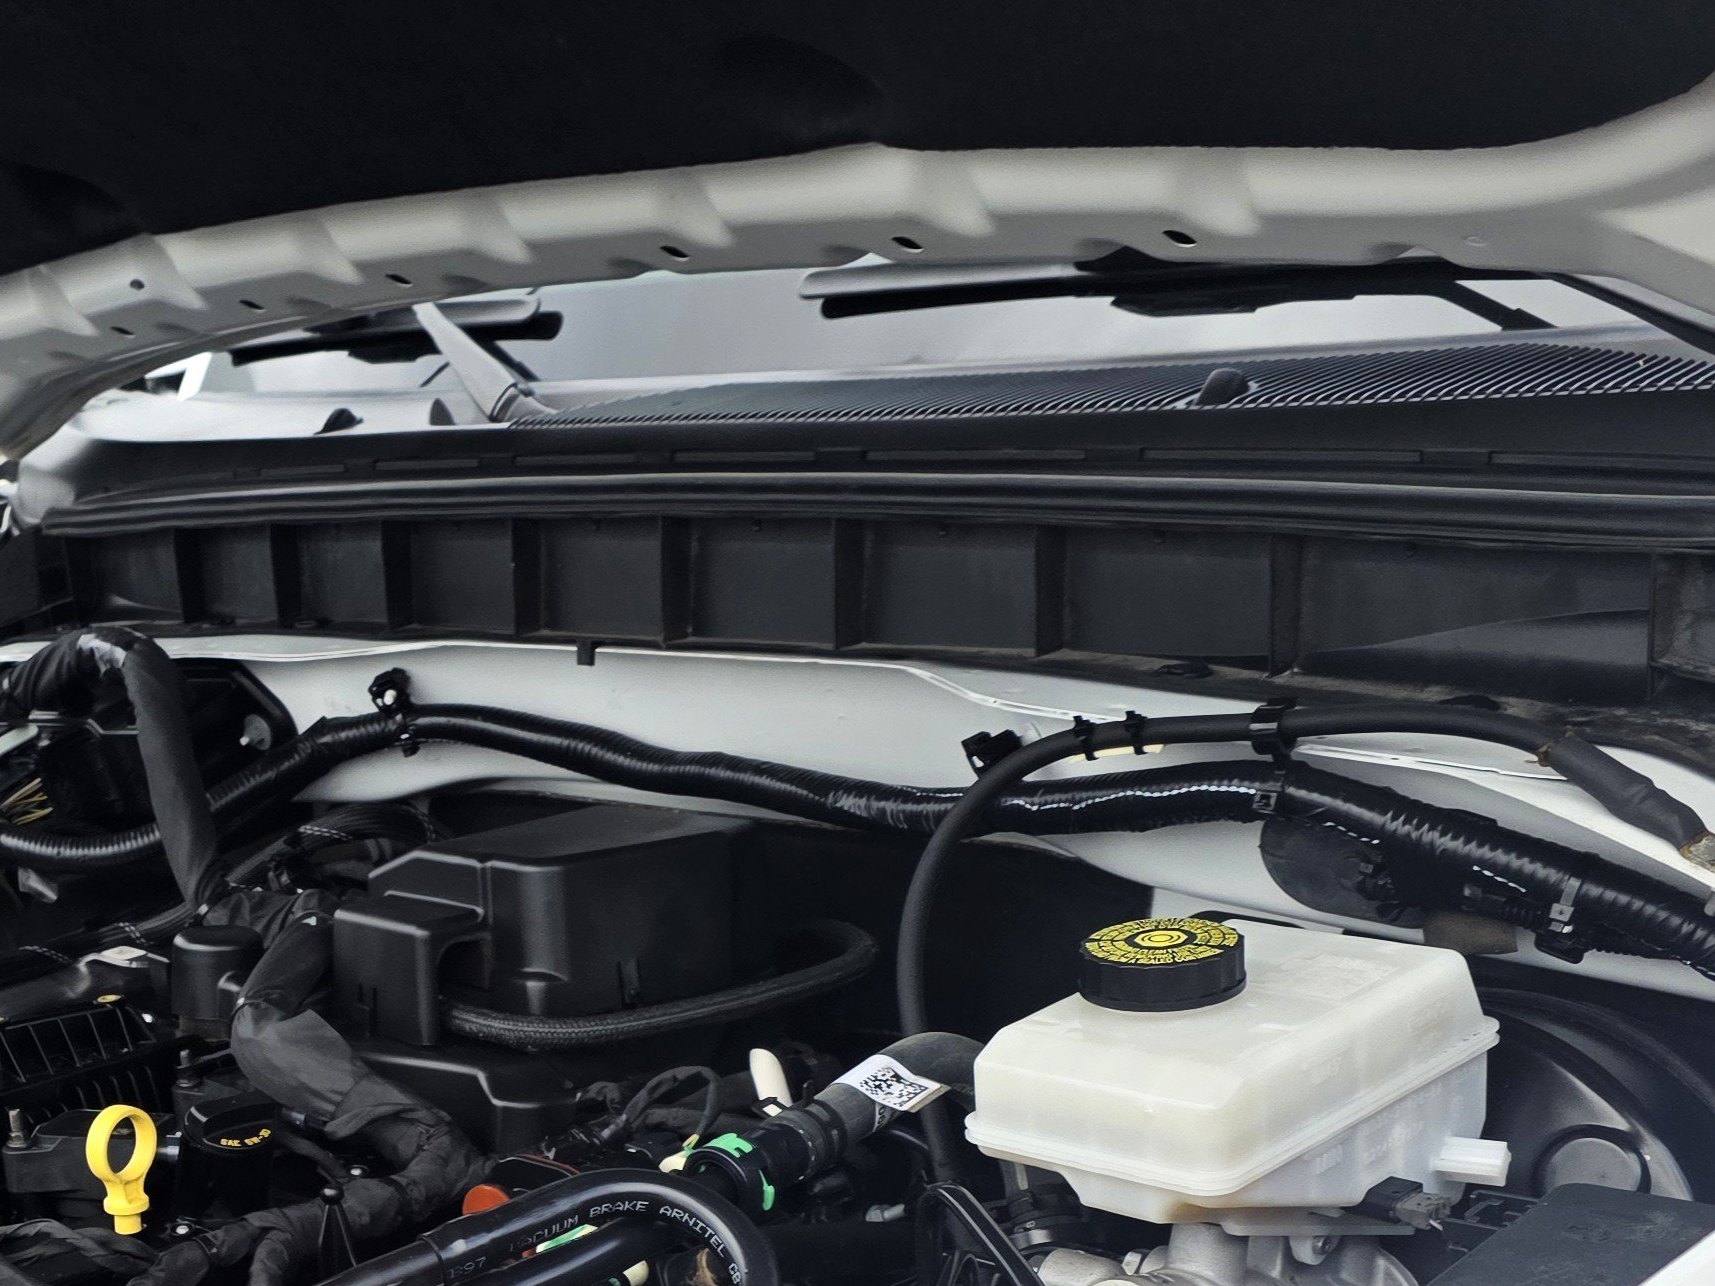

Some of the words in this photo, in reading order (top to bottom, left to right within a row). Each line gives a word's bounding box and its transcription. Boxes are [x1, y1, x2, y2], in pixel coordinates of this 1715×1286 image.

[219, 1138, 243, 1147] SAE
[588, 1200, 649, 1218] BRAKE
[658, 1205, 725, 1258] ARNITEL
